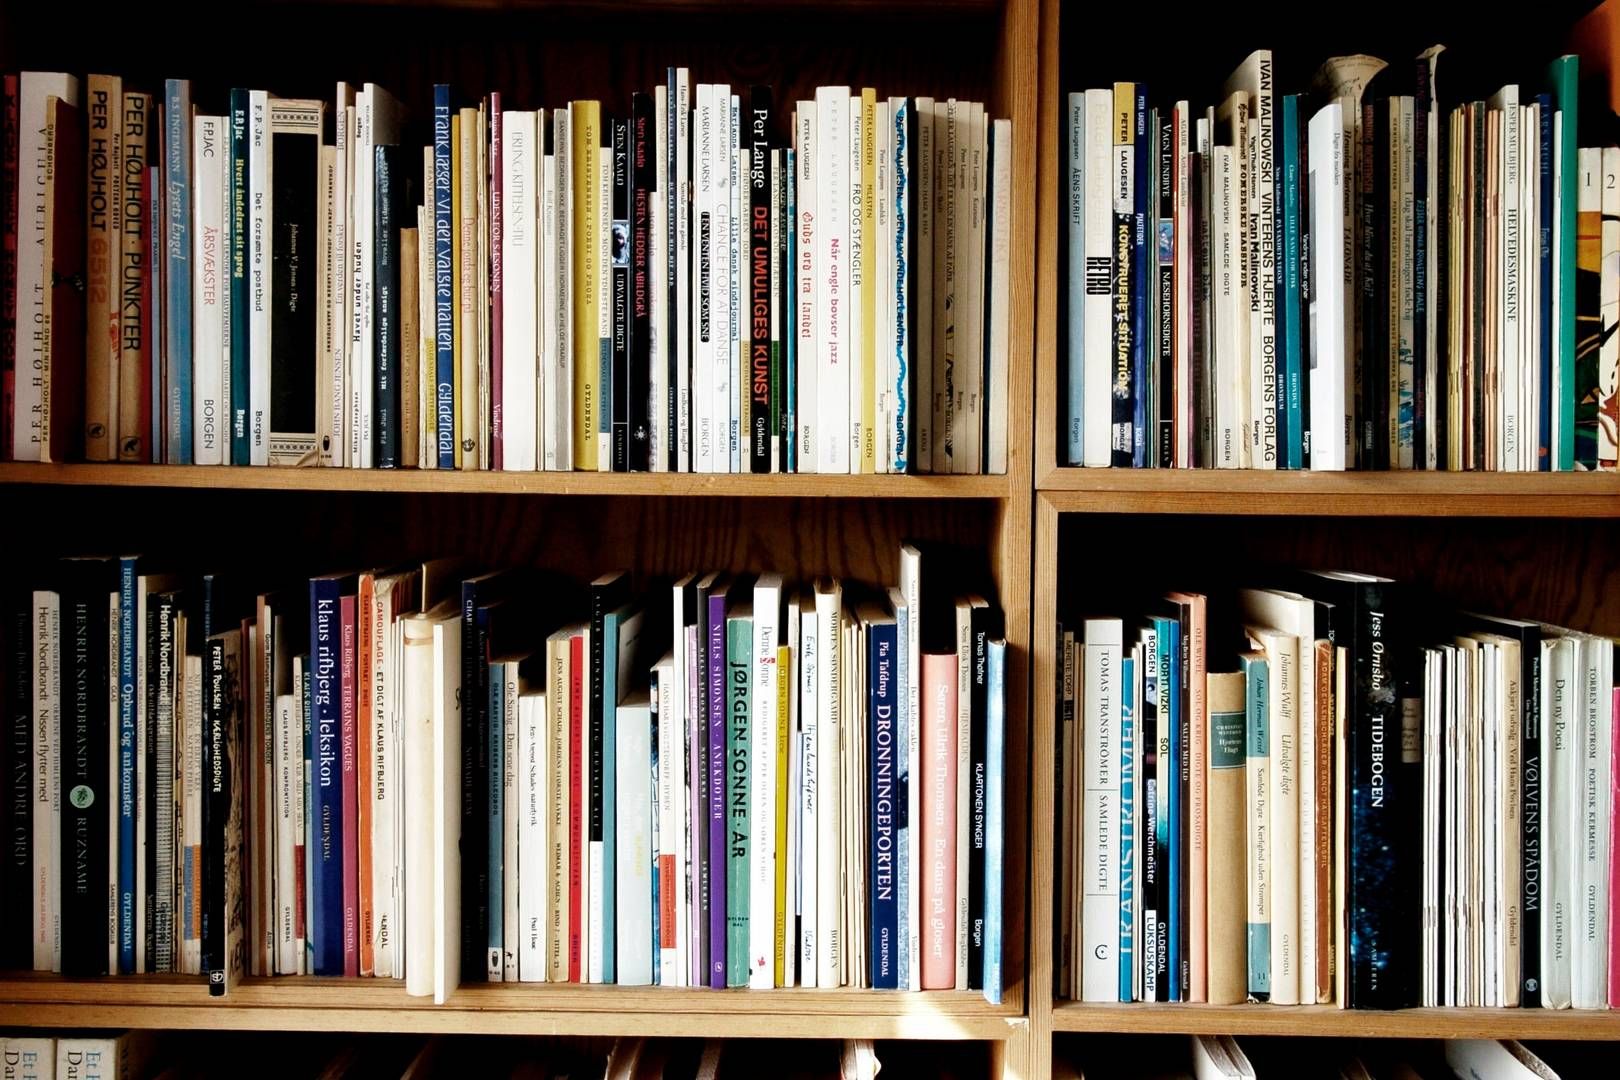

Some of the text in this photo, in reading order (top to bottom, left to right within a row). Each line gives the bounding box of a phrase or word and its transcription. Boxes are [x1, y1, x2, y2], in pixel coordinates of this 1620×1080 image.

[436, 106, 450, 148] Frank
[702, 106, 710, 192] MARIANNE LARSEN
[1072, 126, 1080, 159] Laugesen
[90, 90, 107, 304] PER HØJHOLT 6512
[169, 114, 185, 260] INGEMANN Lysets Engel
[254, 192, 262, 210] Det
[1073, 168, 1082, 192] ÅENS
[1120, 150, 1128, 199] LAUGESEN
[1261, 60, 1274, 326] IVAN MALINOWSKI VINTERENS HJERTE
[1586, 172, 1591, 186] 1
[1607, 174, 1616, 188] 2
[124, 96, 144, 350] PER HØJHOLT PUNKTER
[254, 218, 263, 264] forsømte
[436, 220, 450, 246] der
[1507, 103, 1517, 322] JESPER MULBJERG HELVEDESMASKINE
[204, 227, 218, 305] ÅRSVÆKSTER
[354, 242, 362, 273] huden
[752, 109, 768, 405] Per Lange DET UMULIGES KUNST
[1086, 257, 1111, 295] RETRO
[1250, 213, 1261, 312] Ivan Malinowski
[234, 159, 245, 437] Hvert åndedræt sit sprog Borgen
[253, 271, 263, 311] postbud
[616, 274, 625, 352] UDVALGTE DIGTE
[829, 239, 840, 364] Når engle bovser jazz
[1163, 272, 1171, 356] NÆSEHORNSDIGTE
[353, 313, 361, 342] Havet
[1118, 323, 1130, 391] SITUATION
[173, 388, 181, 440] GYLDENDAL
[204, 400, 214, 449] BORGEN
[1264, 336, 1275, 461] BORGENS FORLAG
[253, 411, 262, 446] Borgen
[702, 418, 710, 456] BORGEN
[755, 417, 765, 456] Gyldendal
[213, 646, 221, 671] PETER
[344, 624, 353, 646] Klaus
[376, 602, 384, 664] CAMOUFLAGE
[977, 632, 985, 656] Tomas
[1148, 635, 1156, 673] BORGEN
[1370, 612, 1384, 690] Jess Ørnsbo
[213, 674, 222, 709] POULSEN
[343, 648, 353, 678] Rifbjerg
[376, 672, 384, 682] ET
[1160, 654, 1169, 713] MORTI VIZKI
[1279, 653, 1291, 718] Johannes Wulff
[1589, 667, 1597, 704] TORBEN
[36, 607, 50, 802] Henrik Nordbrandt Nissen flytter med
[120, 568, 133, 817] HENRIK NORDBRANDT Opbrud og ankomster
[316, 600, 335, 786] klaus rifbjerg leksikon
[344, 686, 352, 732] TERRAINS
[376, 685, 384, 706] DIGT
[377, 710, 384, 720] AF
[1100, 651, 1112, 784] TOMAS TRANSTRÖMER
[1553, 679, 1566, 750] Den ny Poesi
[713, 624, 722, 819] NIELS SIMONSEN ANEKDOTER
[1160, 737, 1169, 757] SOL
[377, 756, 385, 800] RIFBJERG
[730, 662, 748, 858] JØRGEN SONNE ÅR
[877, 642, 892, 900] Pia Tafdrup DRONNINGEPORTEN
[1280, 734, 1291, 795] Udvalgte digte
[1372, 715, 1384, 808] TIDEBOGEN
[322, 805, 330, 861] GYLDENDAL
[975, 763, 984, 848] KLARTONEN SYNGER
[1525, 756, 1541, 911] VØLVENS SPÅDOM
[1099, 795, 1108, 890] SAMLEDE DIGTE
[1147, 818, 1155, 884] Werchmeister
[124, 892, 132, 951] GYLDENDAL
[973, 919, 983, 946] Borgen
[1588, 885, 1596, 941] GYLDENDAL
[1146, 917, 1155, 992] LUKSUSKAMP
[1158, 922, 1166, 974] GYLDENDAL
